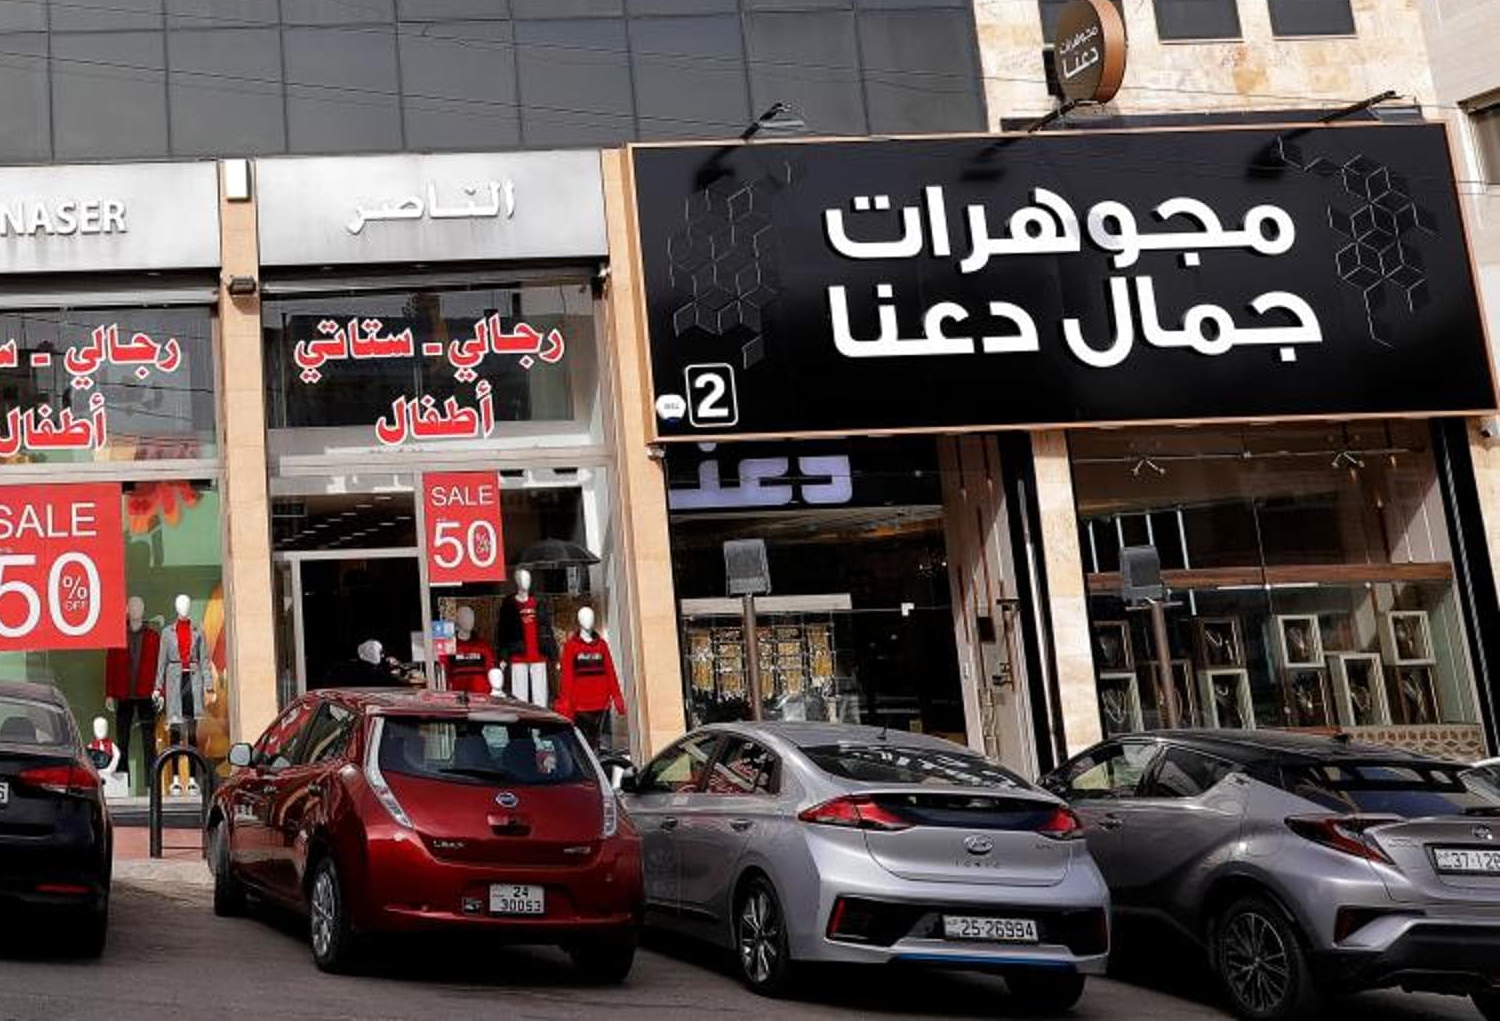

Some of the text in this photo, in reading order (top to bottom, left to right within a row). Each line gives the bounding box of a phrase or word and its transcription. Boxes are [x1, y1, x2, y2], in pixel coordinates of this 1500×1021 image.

[347, 178, 516, 236] الناصر
[825, 187, 1296, 274] مجوهرات
[64, 321, 182, 390] رجالي
[294, 316, 415, 384] ستاتي
[448, 312, 565, 384] رجالي
[827, 275, 1324, 368] جمال دعنا
[374, 379, 496, 445] أطفال
[694, 372, 730, 418] 2
[431, 483, 495, 507] SALE
[669, 442, 853, 510] دعن
